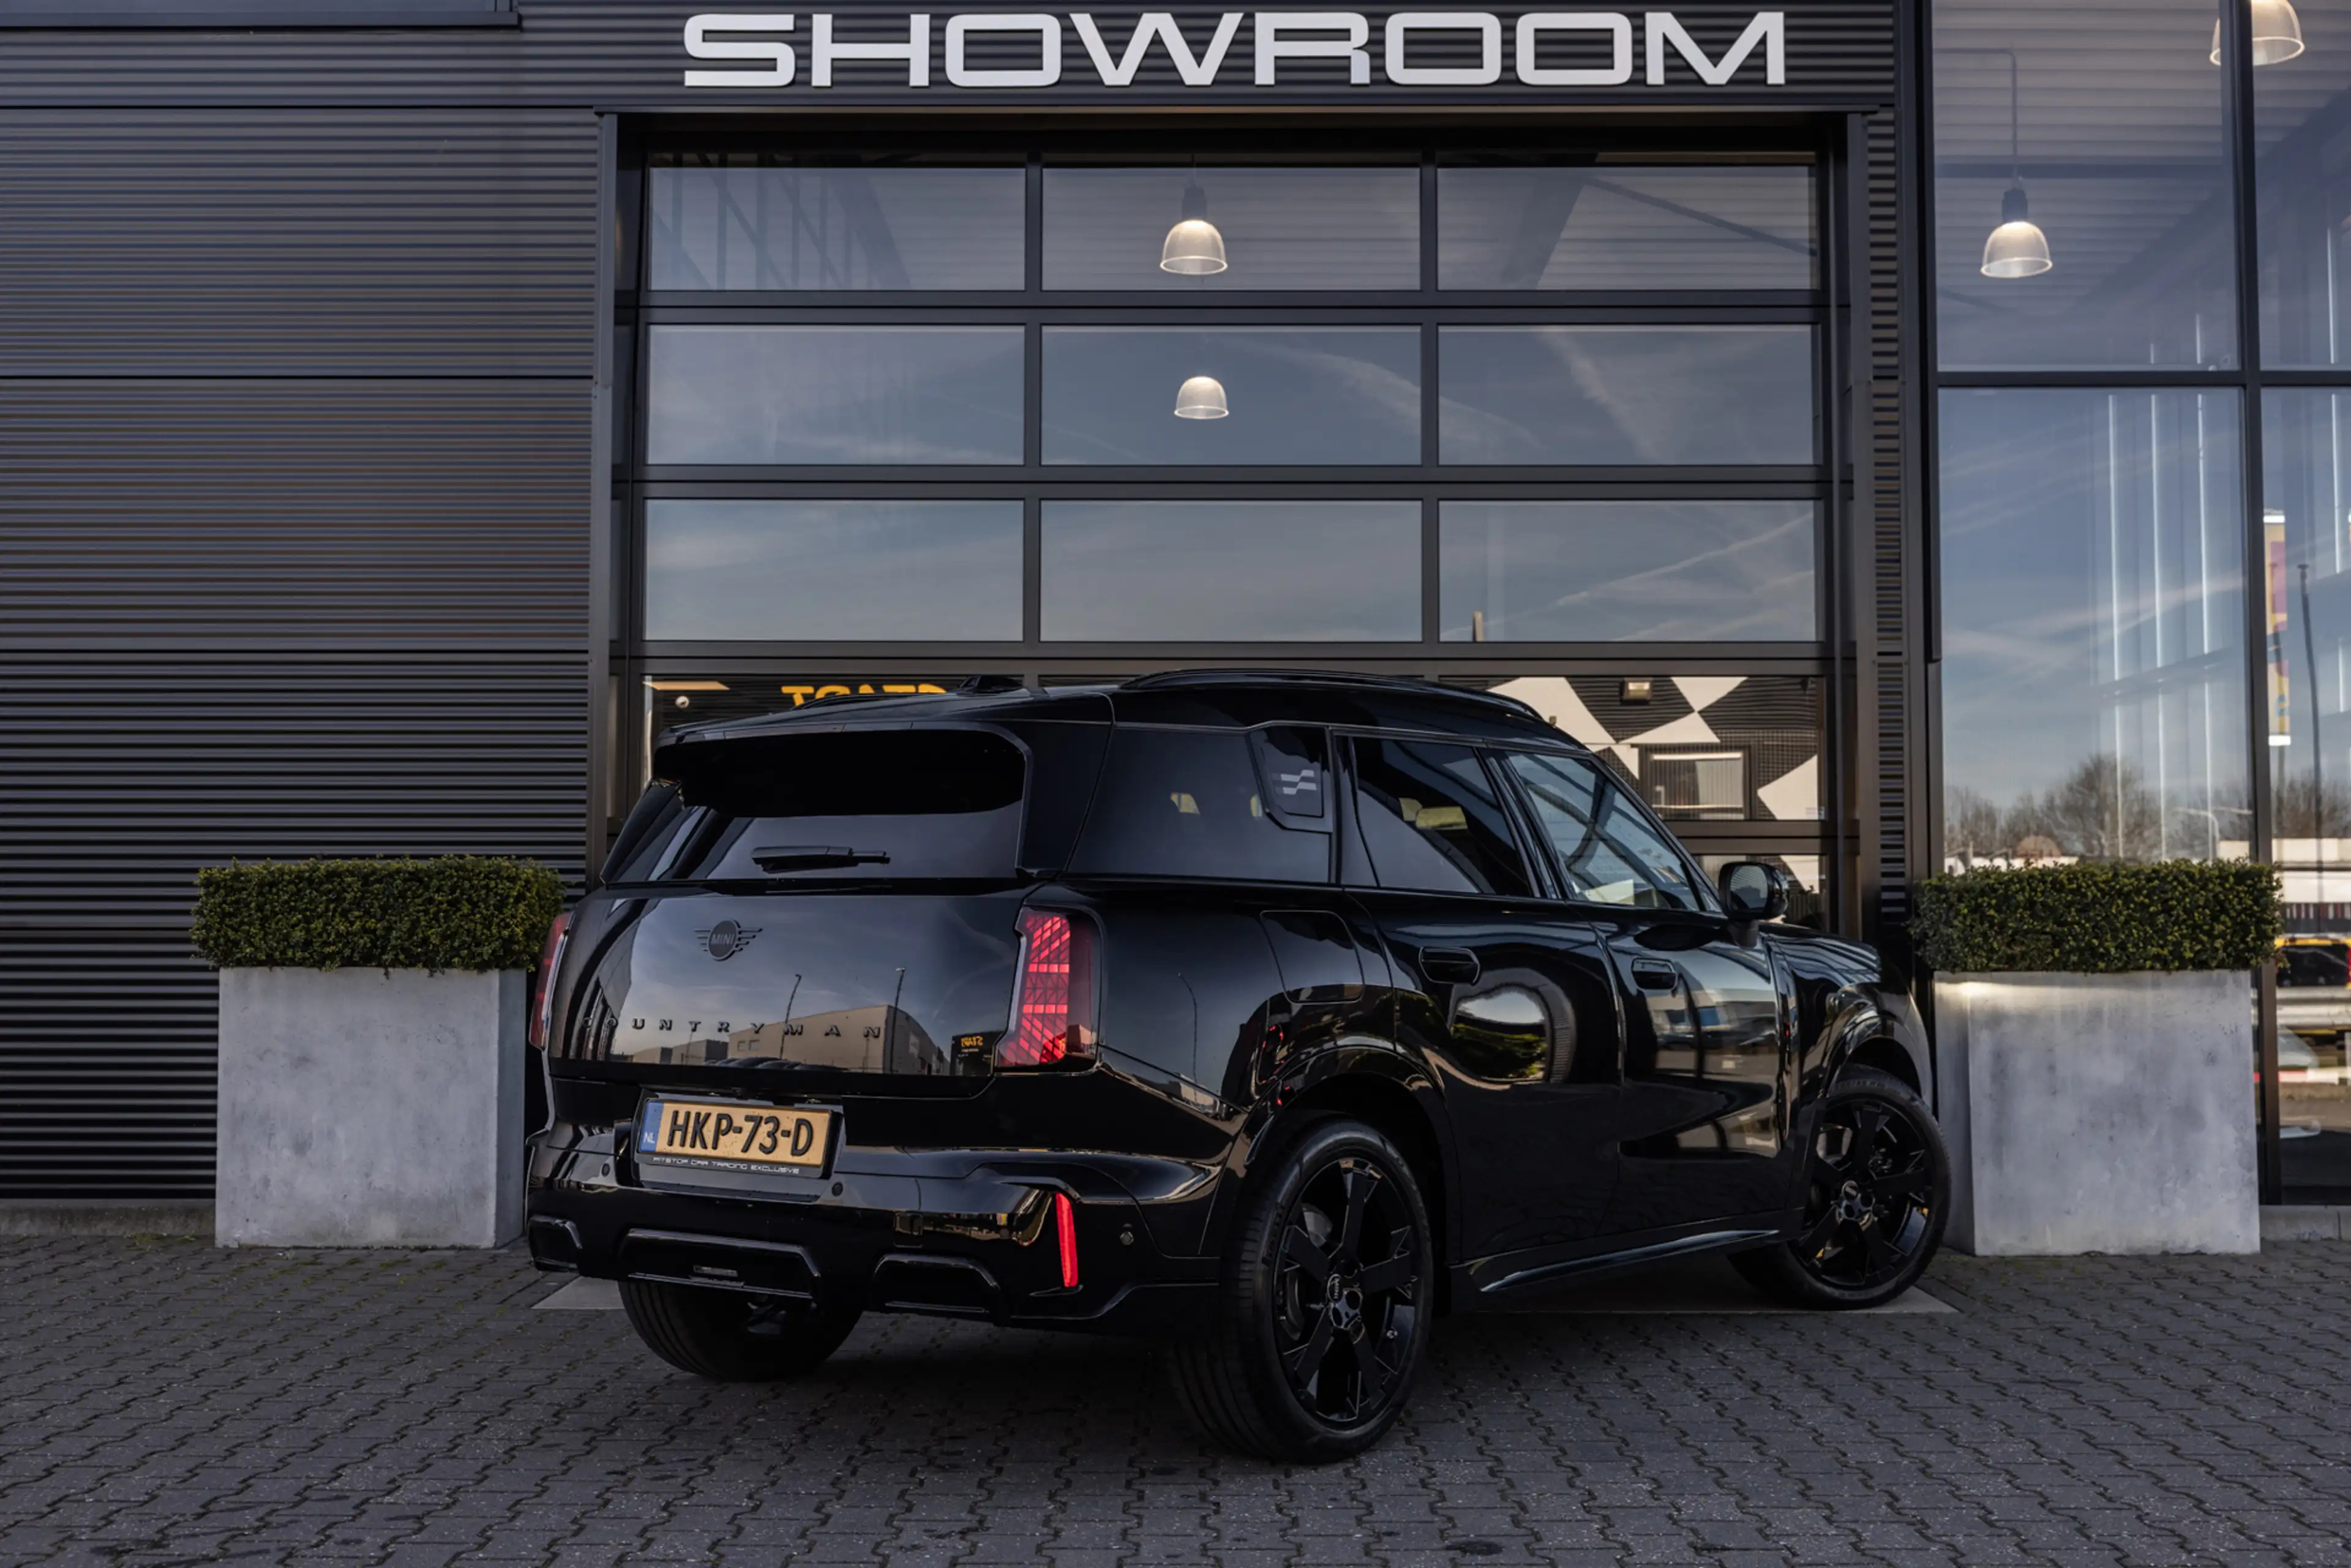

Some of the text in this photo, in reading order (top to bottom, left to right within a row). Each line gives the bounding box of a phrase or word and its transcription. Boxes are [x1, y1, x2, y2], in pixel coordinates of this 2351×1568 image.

[684, 12, 1786, 88] SHOWROOM
[711, 934, 735, 945] MINI
[643, 1132, 654, 1144] NL
[667, 1110, 813, 1157] HKP-73-D
[751, 1165, 800, 1174] EXCLUSIVE
